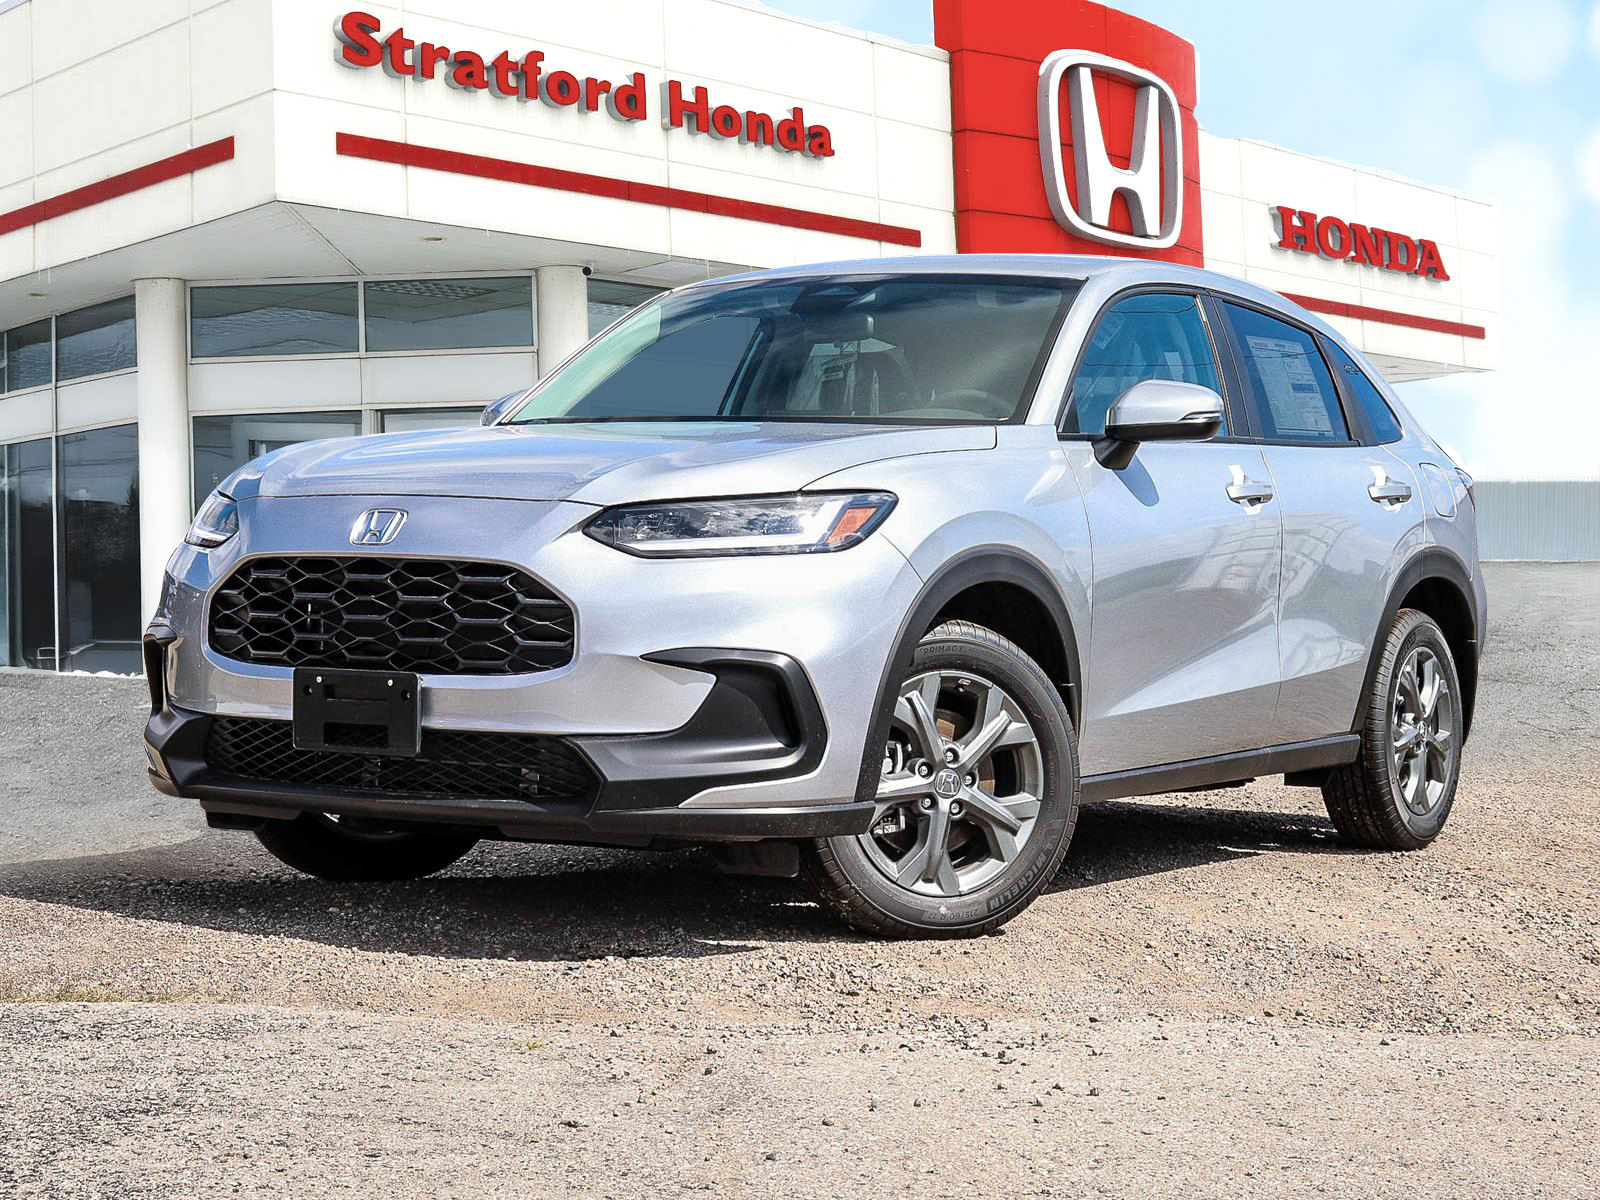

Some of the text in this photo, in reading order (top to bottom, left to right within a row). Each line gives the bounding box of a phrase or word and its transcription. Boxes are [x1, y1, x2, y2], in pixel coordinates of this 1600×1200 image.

[338, 11, 835, 158] Stratford Honda
[1271, 205, 1450, 282] HONDA
[923, 645, 964, 656] PRIMACY
[990, 851, 1047, 910] MICHELIN
